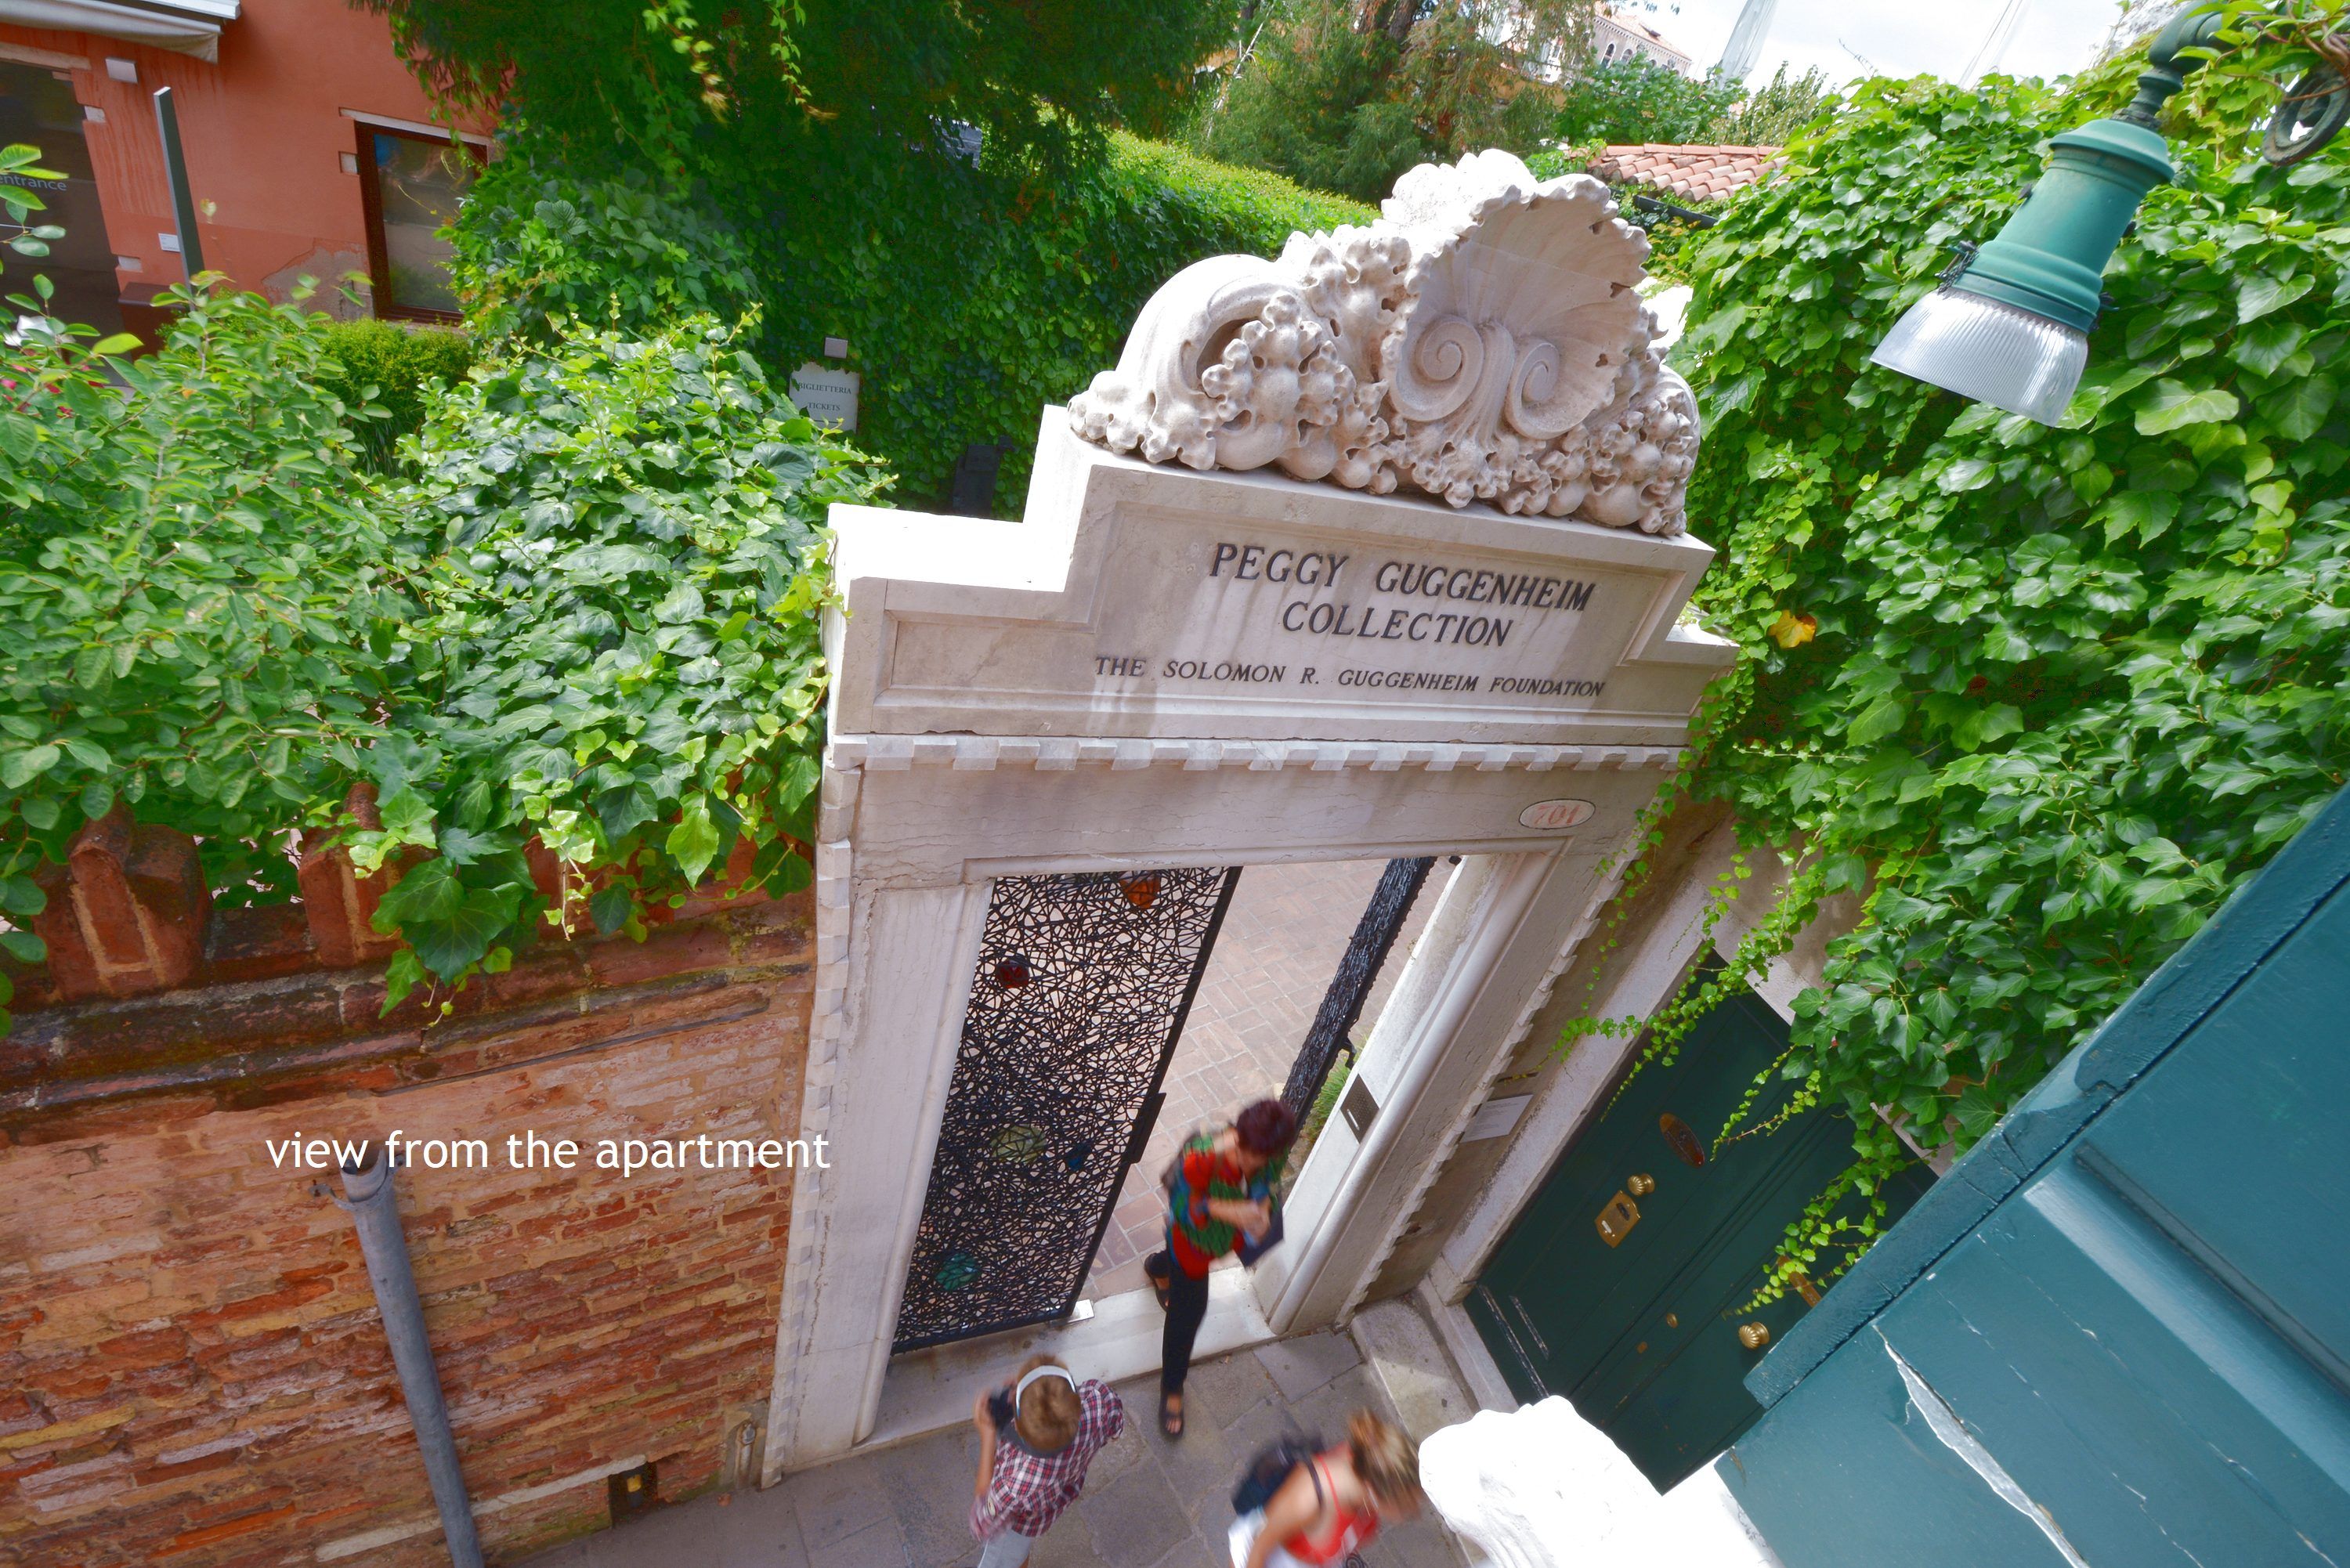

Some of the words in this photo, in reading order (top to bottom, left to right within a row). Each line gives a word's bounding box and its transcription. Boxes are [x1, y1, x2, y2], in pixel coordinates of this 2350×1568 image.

[799, 382, 851, 394] BIGLIETTERIA
[808, 402, 841, 411] TICKETS
[1209, 543, 1350, 587] PEGGY
[1376, 562, 1596, 612] GUGGENHEIM
[1283, 602, 1514, 646] COLLECTION
[1095, 656, 1147, 677] THE
[1163, 660, 1286, 684] SOLOMON
[1300, 667, 1320, 685] R.
[1338, 669, 1479, 692] GUGGENHEIM
[1488, 677, 1606, 697] FOUNDATION
[1533, 804, 1581, 825] 701
